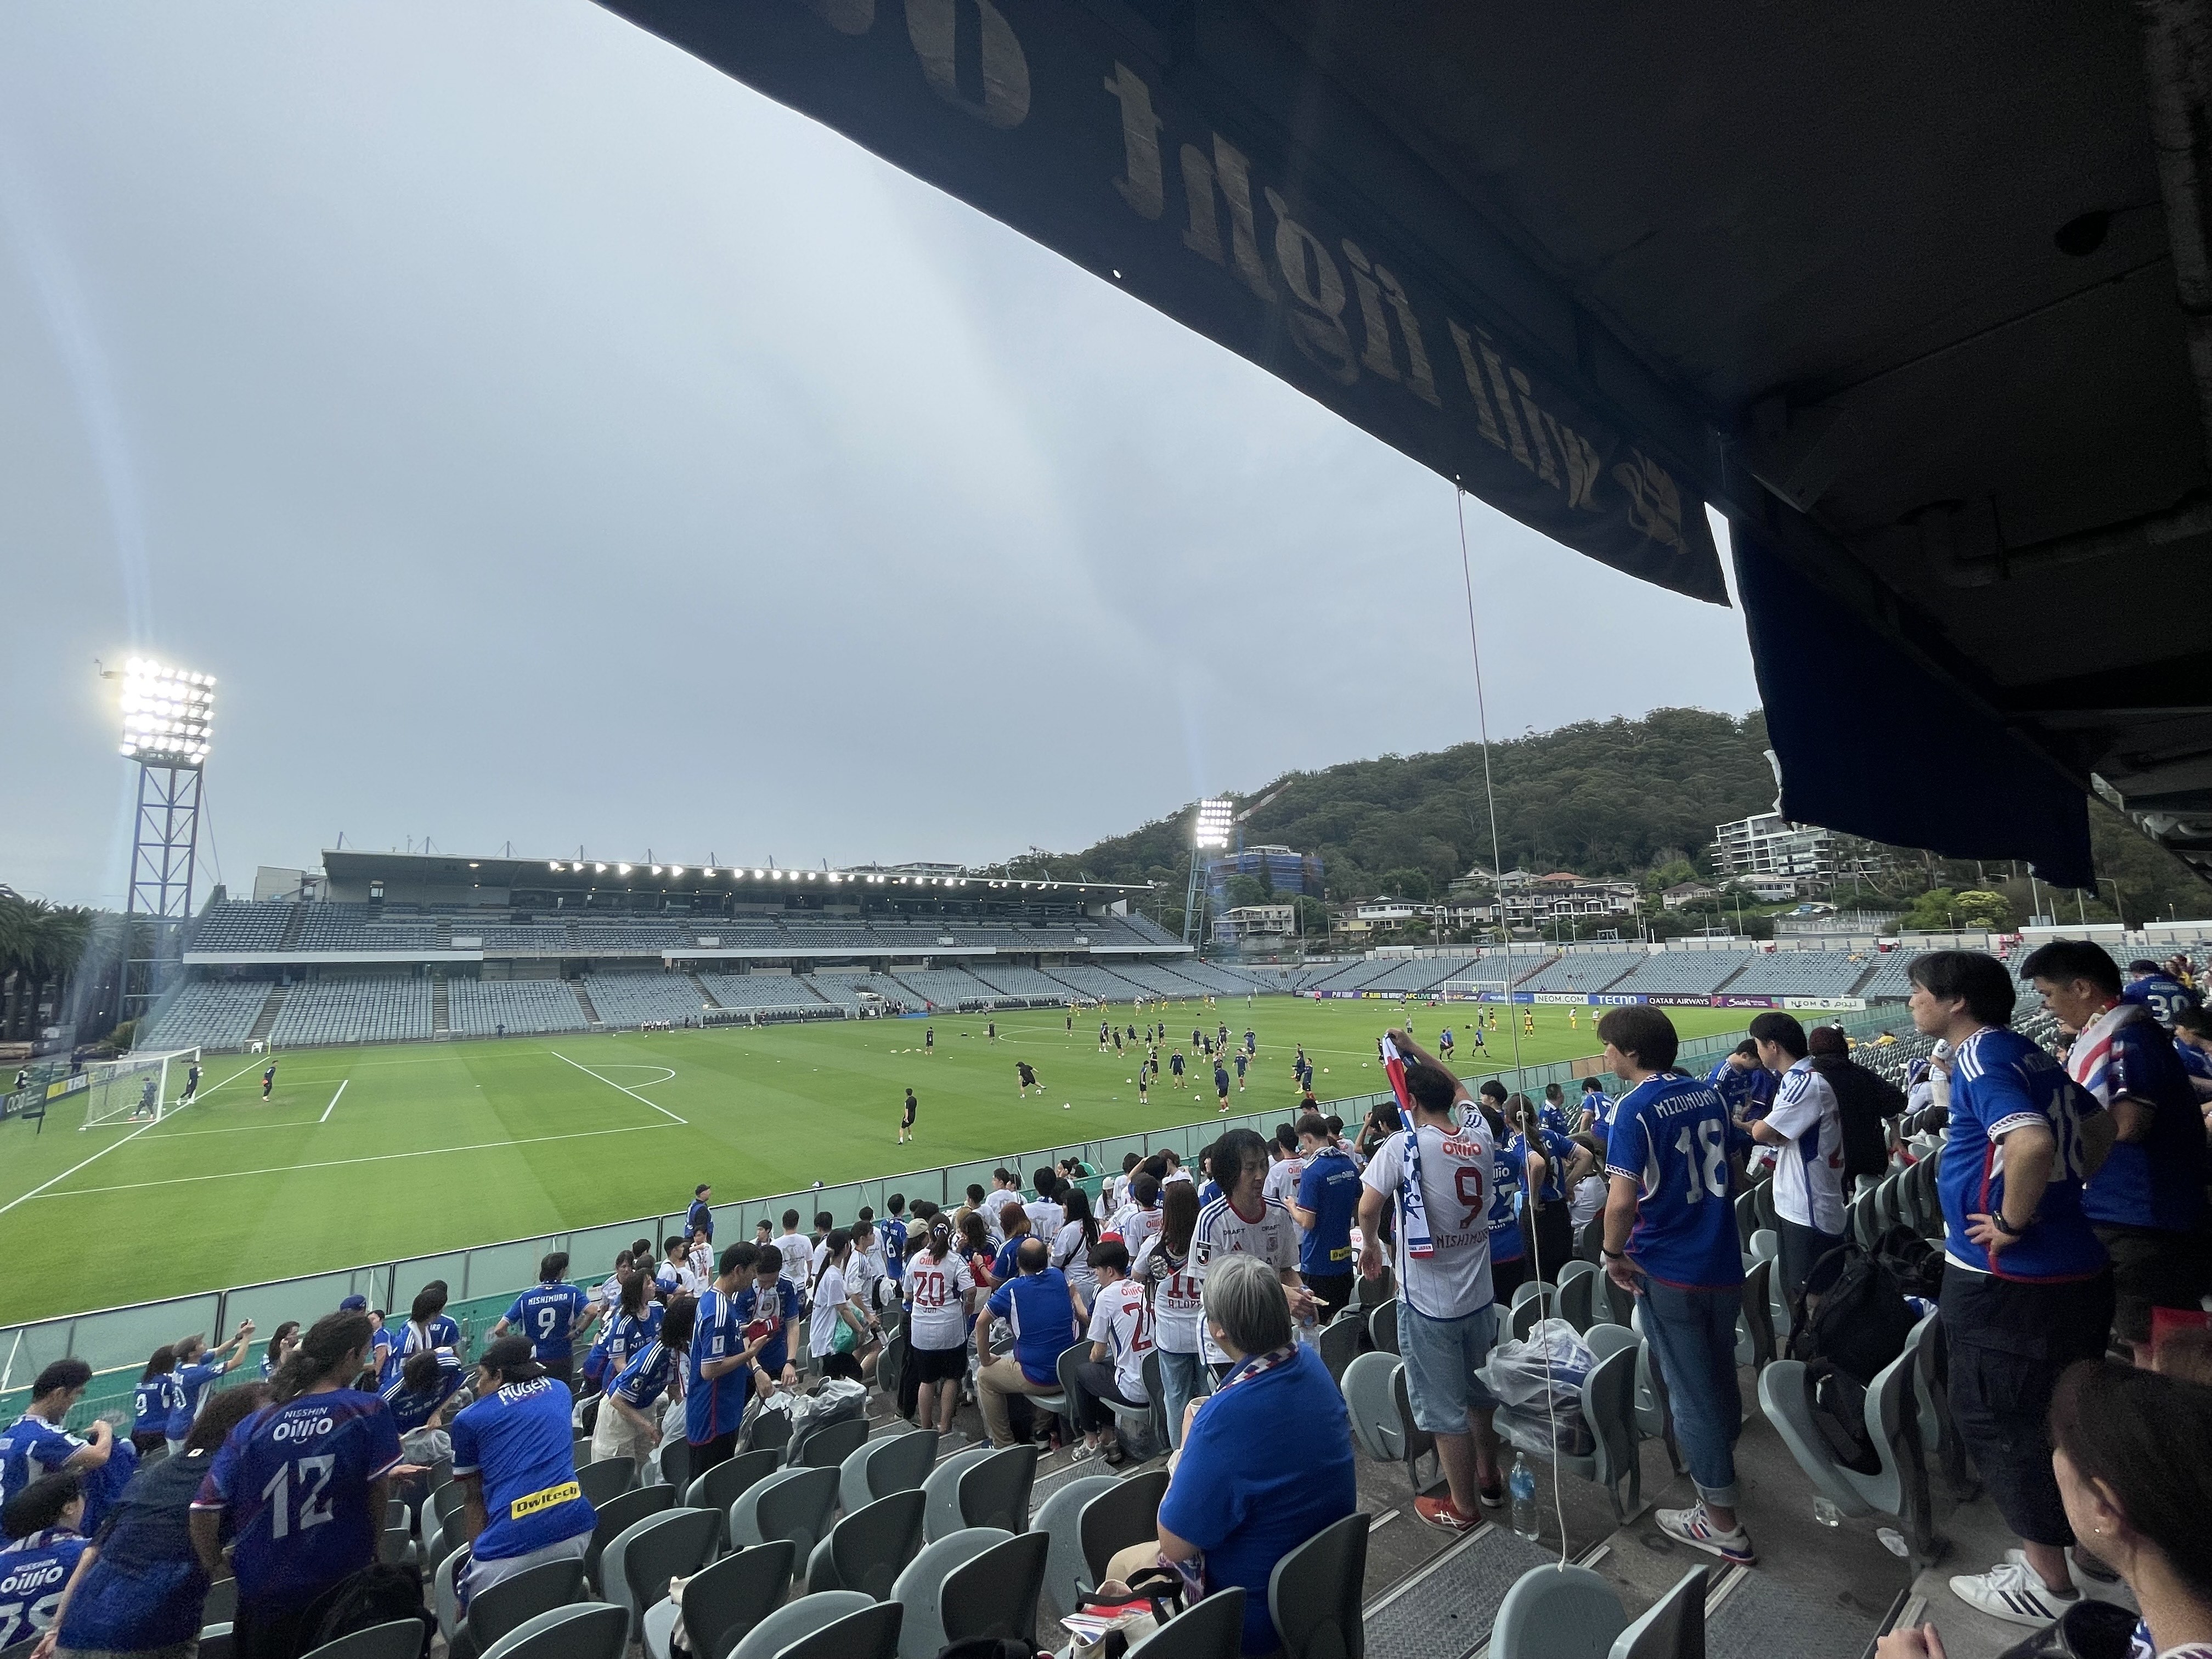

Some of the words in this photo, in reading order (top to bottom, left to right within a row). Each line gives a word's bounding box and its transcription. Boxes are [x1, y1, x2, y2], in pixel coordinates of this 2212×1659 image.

[1538, 995, 1584, 1003] NEOM.COM
[1596, 995, 1638, 1005] TECNO
[1653, 1089, 1718, 1119] MIZUNUMA
[1674, 1118, 1728, 1204] 18
[1454, 1166, 1483, 1230] 9
[886, 1235, 896, 1259] 6
[528, 1293, 568, 1306] NISHIMURA
[913, 1271, 945, 1306] 20
[538, 1307, 556, 1339] 9
[497, 1375, 551, 1402] MUGEN
[135, 1393, 148, 1417] 9
[284, 1406, 329, 1420] NISSHIN
[261, 1453, 336, 1539] 12
[516, 1486, 577, 1513] Owltech
